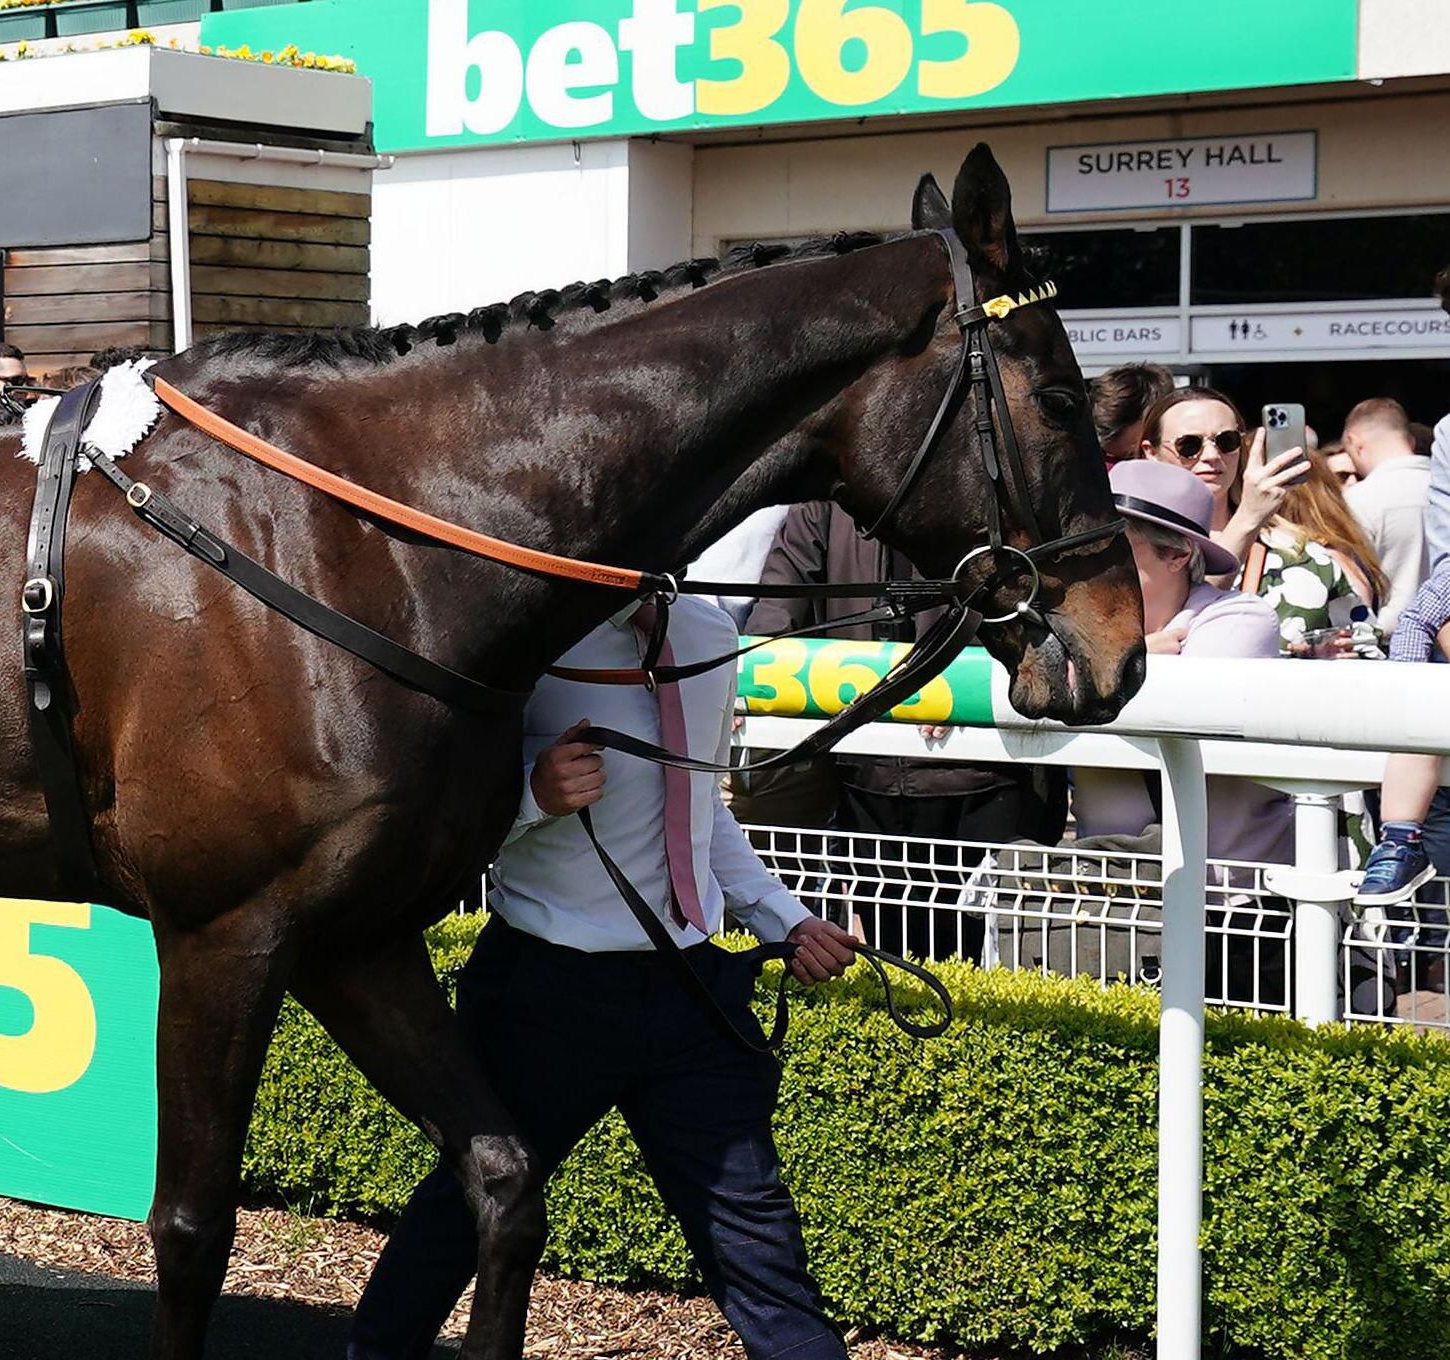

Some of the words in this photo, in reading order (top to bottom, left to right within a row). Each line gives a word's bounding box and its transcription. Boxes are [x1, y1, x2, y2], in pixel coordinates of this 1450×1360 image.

[426, 0, 1020, 137] bet365
[1078, 148, 1193, 174] SURREY
[1205, 143, 1282, 167] HALL
[1165, 178, 1191, 198] 13
[1113, 328, 1162, 341] BARS
[738, 637, 953, 723] 365
